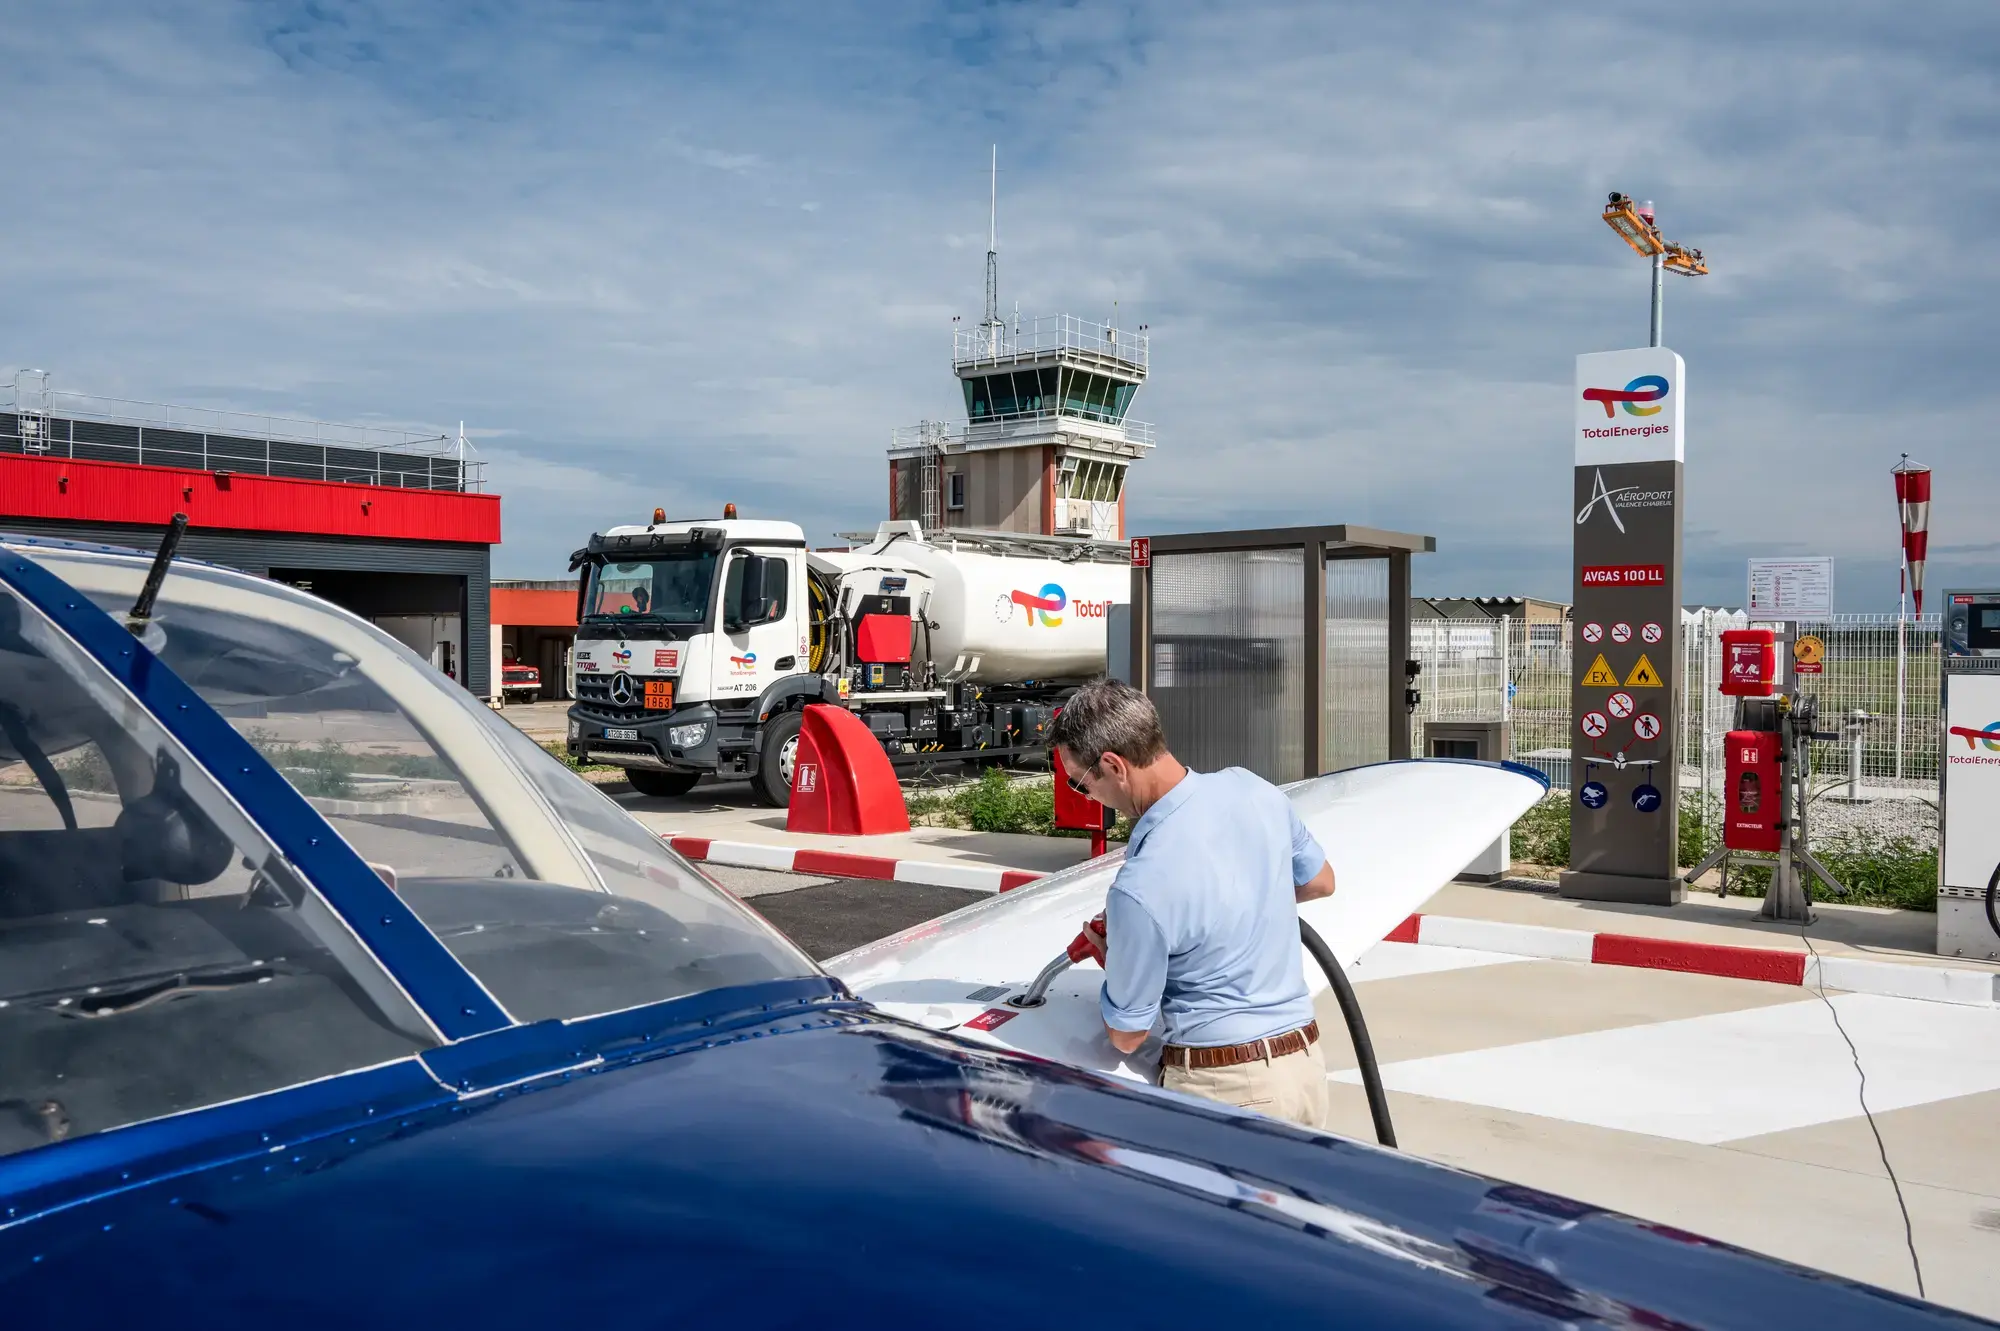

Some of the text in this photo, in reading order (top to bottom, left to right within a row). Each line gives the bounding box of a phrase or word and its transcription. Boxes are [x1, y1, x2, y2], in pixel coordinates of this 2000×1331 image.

[1582, 423, 1669, 438] TotalEnergies
[1616, 490, 1673, 501] AÉROPORT
[1583, 569, 1663, 582] AVGAS 100 LL
[1072, 599, 1113, 618] Total
[1592, 671, 1608, 683] EX
[652, 683, 664, 693] 30
[734, 684, 743, 692] AT
[744, 683, 757, 692] 206
[646, 697, 670, 709] 1863
